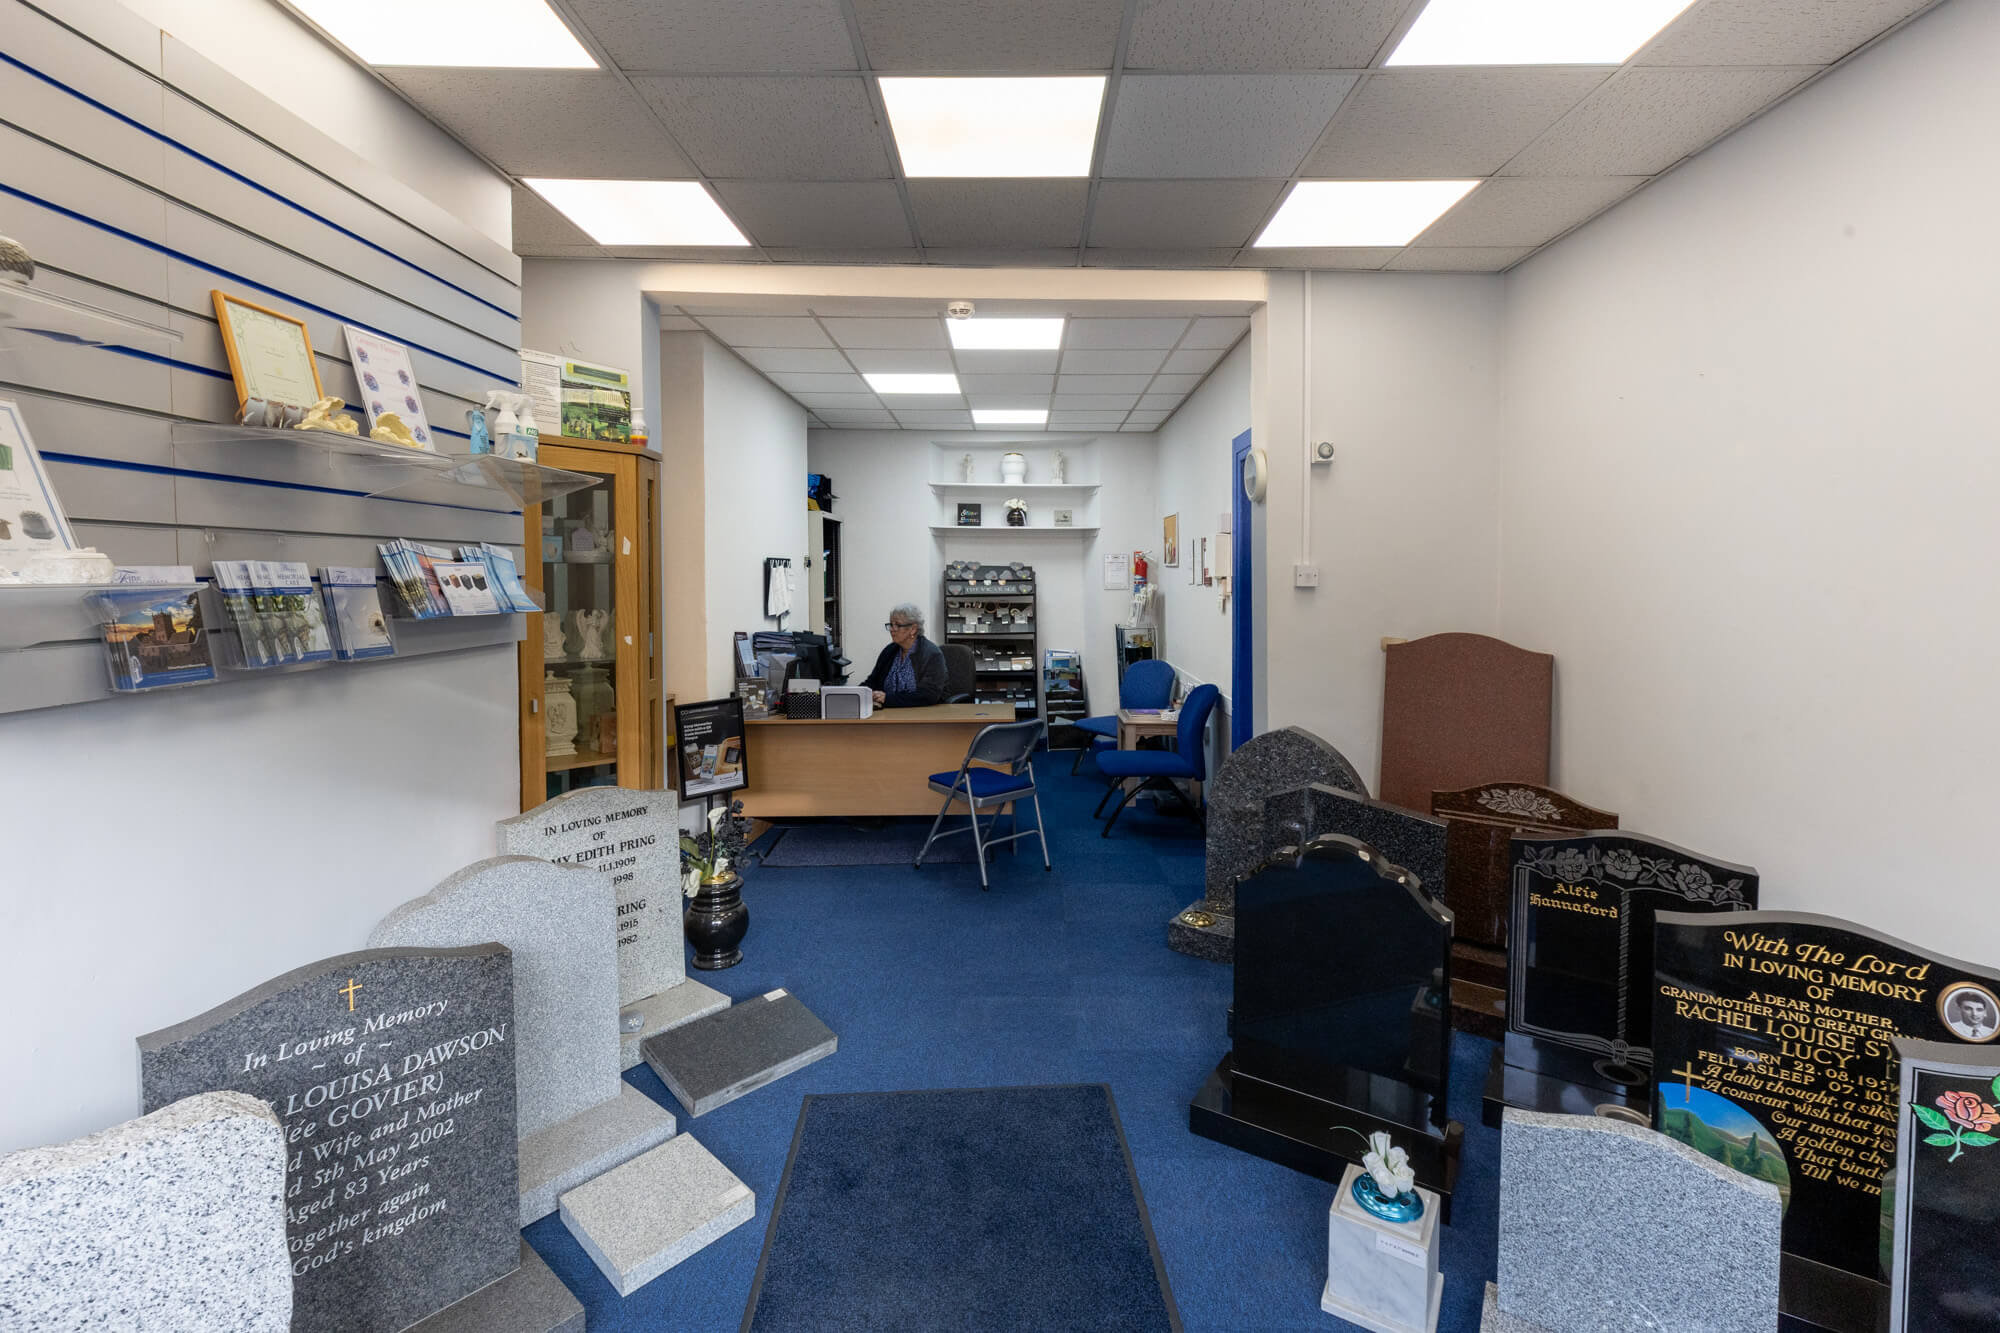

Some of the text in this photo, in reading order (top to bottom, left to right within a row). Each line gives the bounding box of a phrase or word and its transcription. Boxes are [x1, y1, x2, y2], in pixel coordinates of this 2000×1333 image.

[544, 806, 648, 836] IN LOVING MEMORY
[592, 831, 606, 841] OF
[576, 844, 615, 863] EDITH
[620, 835, 656, 852] PRING
[617, 899, 646, 916] RING
[1530, 892, 1618, 918] Hannaford
[1553, 882, 1598, 900] Alfie
[1724, 930, 1931, 981] With The Lord
[1723, 953, 1928, 1002] IN LOVING MEMORY
[1806, 986, 1834, 1001] OF
[1660, 986, 1773, 1017] GRANDMOTHER
[1776, 1010, 1811, 1024] AND
[1813, 1016, 1868, 1037] GREAT
[1674, 1001, 1758, 1032] RACHEL
[1765, 1020, 1856, 1052] LOUISE
[1747, 991, 1899, 1032] A DEAR MOTHER,
[242, 1000, 448, 1073] In Loving Memory
[344, 1042, 366, 1066] of
[285, 1023, 508, 1117] LOUISA DAWSON
[1698, 1050, 1738, 1068] FELL
[1744, 1063, 1815, 1085] ASLEEP
[1734, 1046, 1781, 1065] BORN
[327, 1070, 445, 1128] GOVIER)
[1702, 1064, 1722, 1078] A
[1722, 1070, 1764, 1090] daily
[1766, 1082, 1838, 1108] thought,
[1842, 1100, 1855, 1110] a
[1702, 1078, 1722, 1092] A
[1722, 1086, 1791, 1110] constant
[1793, 1102, 1831, 1120] wish
[1833, 1110, 1872, 1130] that
[312, 1088, 484, 1161] Wife and Mother
[1771, 1110, 1808, 1129] Our
[312, 1162, 345, 1189] 5th
[352, 1144, 400, 1172] May
[408, 1118, 455, 1150] 2002
[1776, 1128, 1797, 1142] A
[1797, 1134, 1856, 1158] golden
[1793, 1146, 1838, 1167] That
[1800, 1162, 1833, 1182] Till
[286, 1156, 430, 1224] Aged 83 Years
[378, 1182, 430, 1215] again
[292, 1198, 448, 1276] God's kingdom
